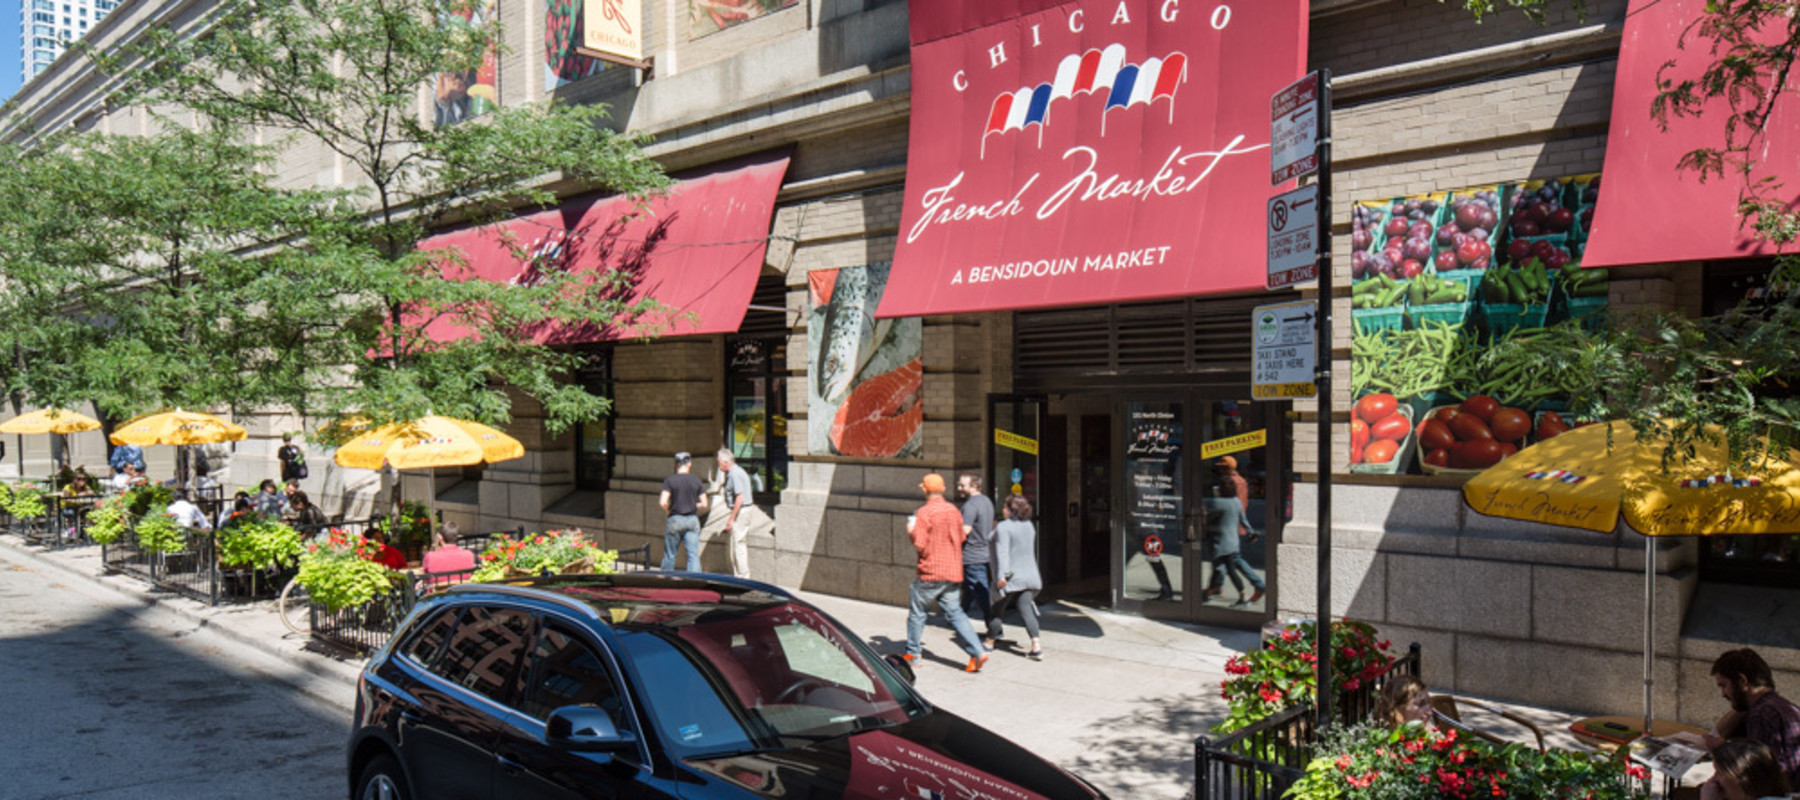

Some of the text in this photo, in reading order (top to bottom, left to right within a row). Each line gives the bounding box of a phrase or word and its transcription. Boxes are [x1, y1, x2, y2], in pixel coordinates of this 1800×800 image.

[952, 0, 1232, 92] CHICAGO
[1274, 157, 1313, 183] TOW ZONE
[906, 134, 1271, 244] French Market
[1295, 231, 1310, 243] ZONE
[951, 246, 1171, 285] A BENSIDOUN MARKET
[1270, 266, 1314, 287] TOW ZONE
[1257, 348, 1297, 360] TAXI STAND
[1265, 360, 1283, 370] TAXIS
[1286, 358, 1305, 369] HERE
[1257, 383, 1310, 397] TOW ZONE
[1203, 433, 1263, 453] FREE PARKING
